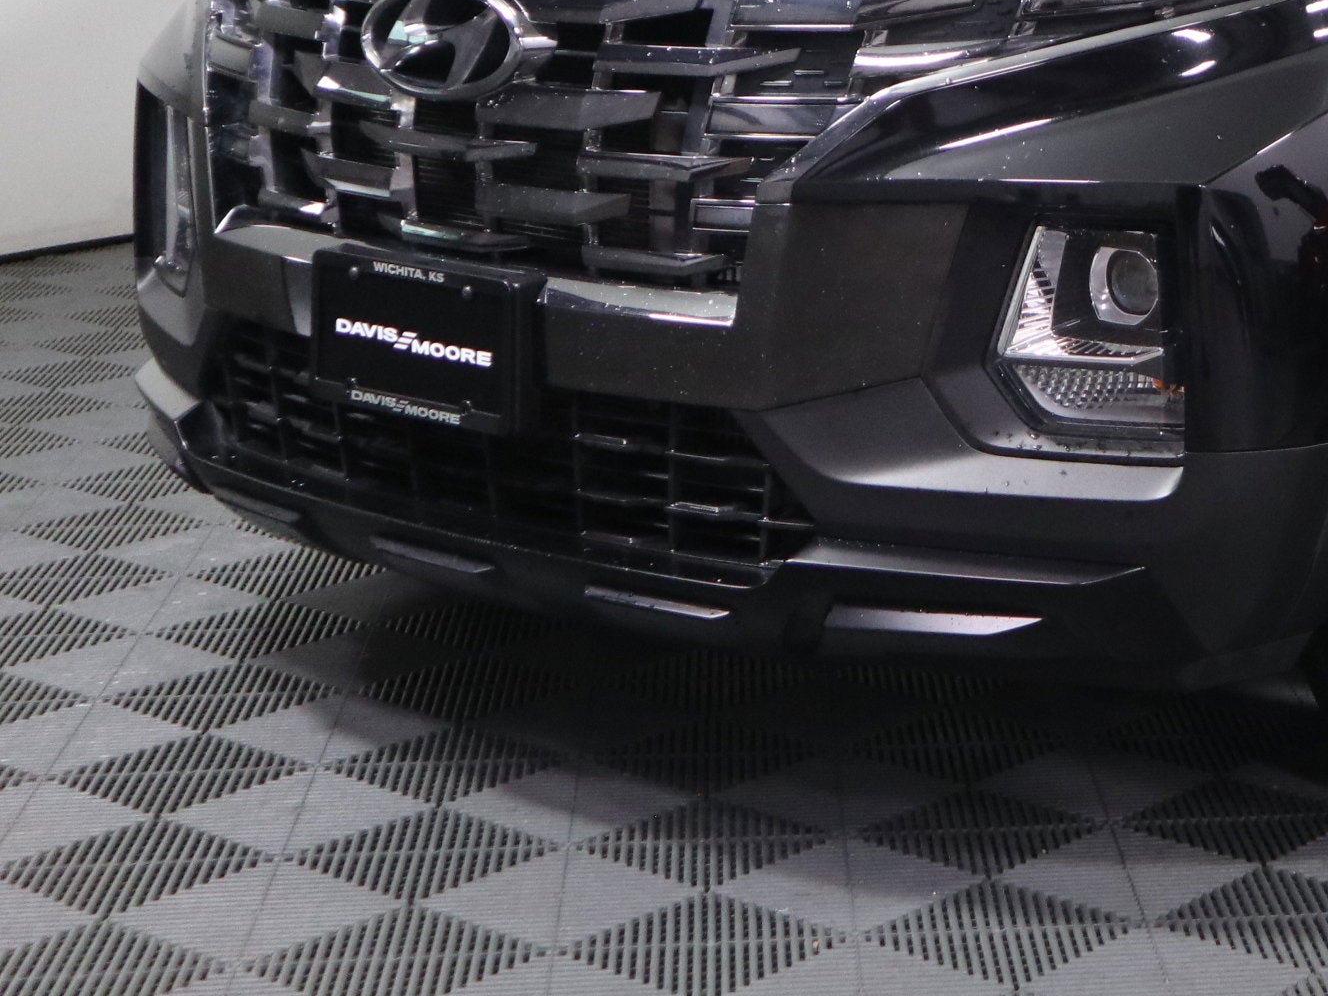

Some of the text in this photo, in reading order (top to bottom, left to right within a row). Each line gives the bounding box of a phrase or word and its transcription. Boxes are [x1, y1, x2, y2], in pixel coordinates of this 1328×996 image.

[428, 271, 445, 283] KS
[335, 318, 493, 367] DAVIS MOORE
[350, 390, 461, 425] DAVIS MOORE
